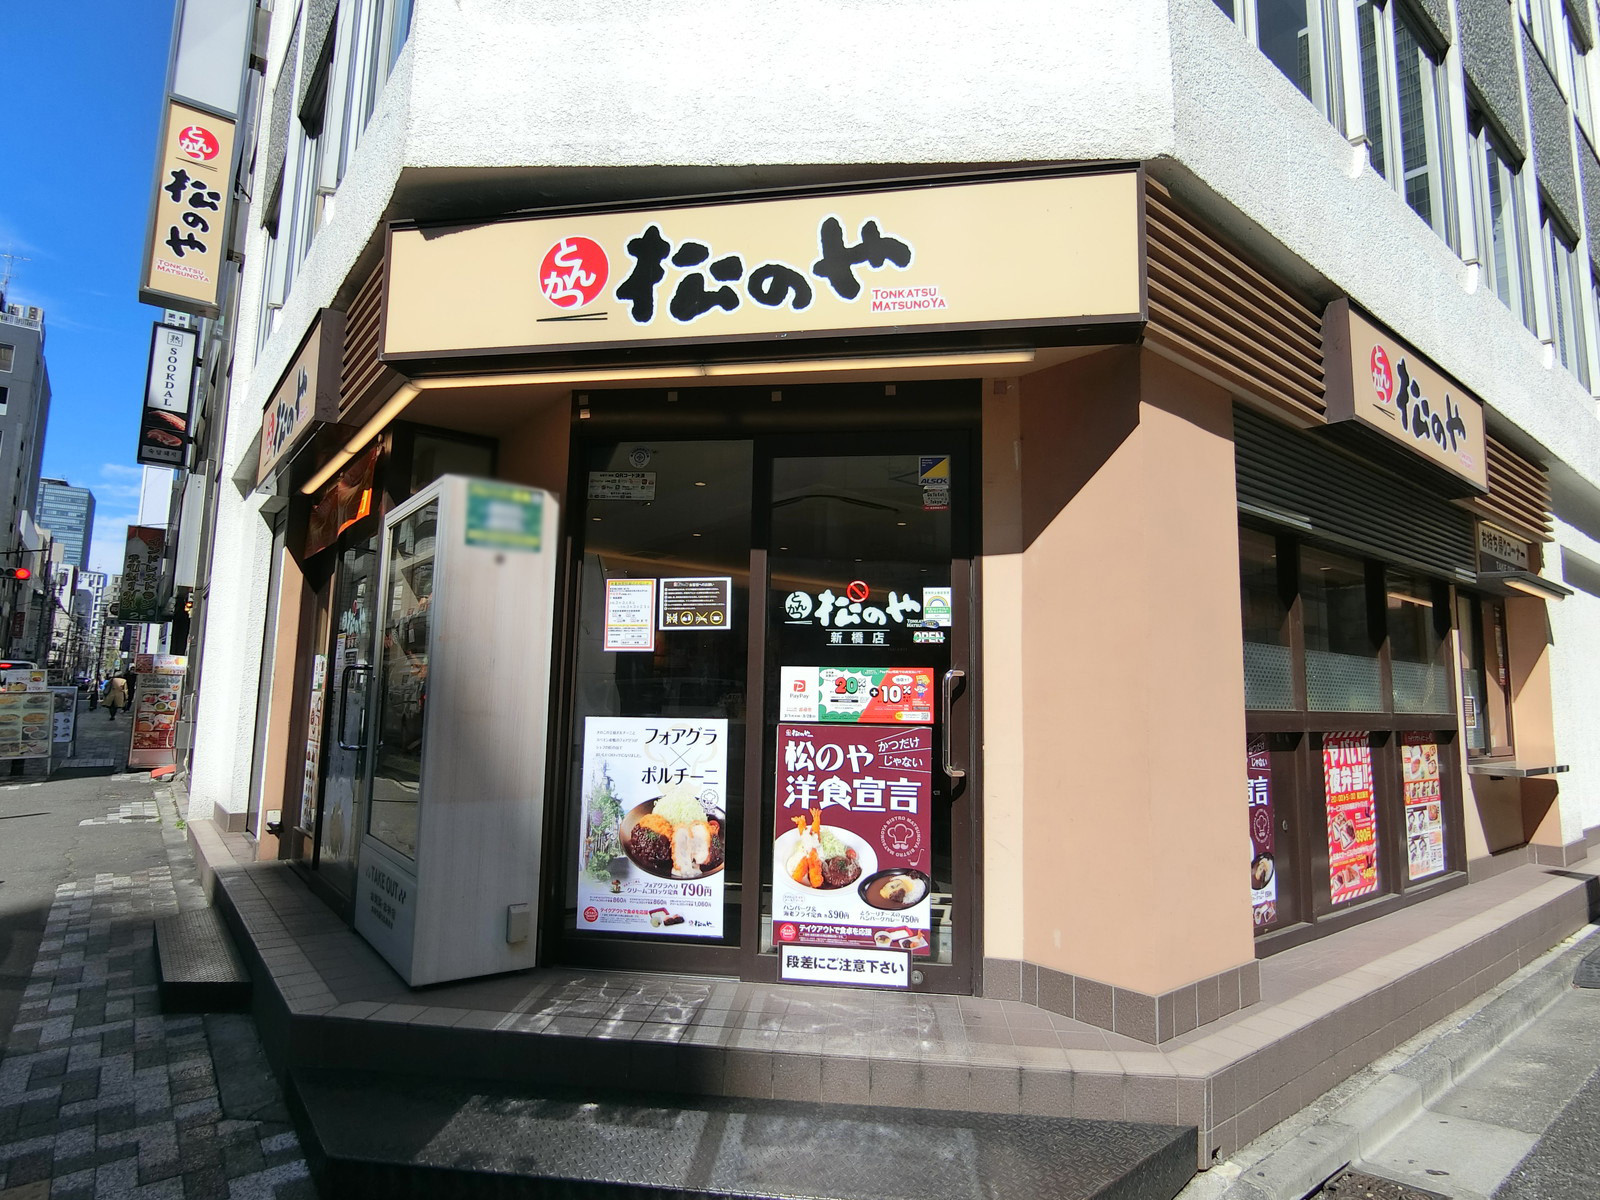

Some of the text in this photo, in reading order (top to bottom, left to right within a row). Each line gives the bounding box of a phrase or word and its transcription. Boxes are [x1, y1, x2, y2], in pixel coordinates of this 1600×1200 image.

[164, 169, 222, 258] 松のや
[157, 264, 210, 283] MATSUNOYA
[159, 259, 205, 276] TONKATSU
[541, 237, 606, 308] とんかつ
[615, 215, 913, 323] 松のや
[872, 288, 938, 300] TONKATSU
[872, 298, 947, 312] MATSUNOYA
[163, 347, 178, 407] SOOKDAL
[1396, 358, 1466, 452] 松のや
[814, 588, 922, 627] 松のや
[830, 632, 885, 644] 新橋店
[913, 631, 945, 643] OPEN
[835, 677, 867, 694] 20%
[881, 685, 912, 703] 10%
[645, 727, 718, 746] フォアグラ
[878, 736, 920, 753] かつだけ
[784, 740, 874, 773] 松のや
[884, 755, 923, 768] じゃない
[641, 765, 719, 786] ポルチーニ
[783, 773, 923, 814] 洋食宣言
[880, 816, 921, 857] BISTRO MATSUNOYA BISTRO MATSUNOYA
[371, 865, 399, 900] TAKE OUT
[681, 883, 712, 897] 790円
[798, 924, 873, 936] テイクアウトで食卓を応援
[786, 954, 905, 974] 段差にご注意下さい
